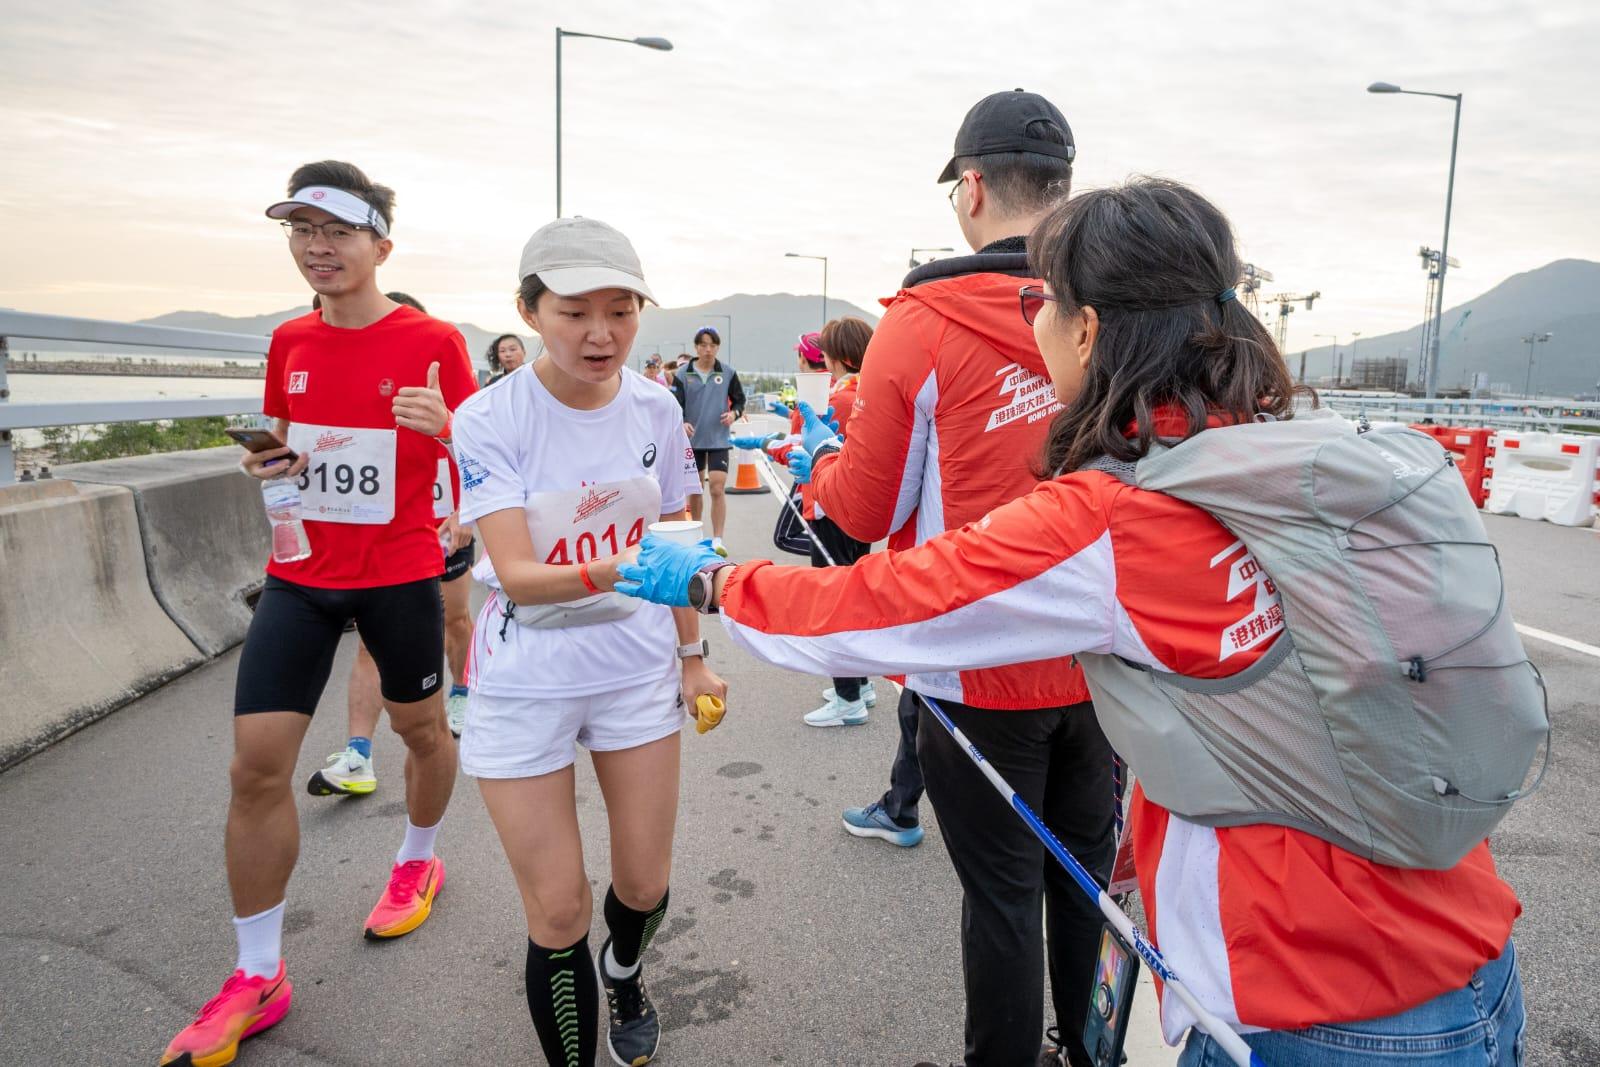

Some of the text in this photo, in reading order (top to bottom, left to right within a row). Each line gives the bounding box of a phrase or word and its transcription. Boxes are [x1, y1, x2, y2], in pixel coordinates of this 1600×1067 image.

[1020, 379, 1044, 397] BANK
[1027, 408, 1047, 424] HONG
[544, 516, 646, 566] 4014
